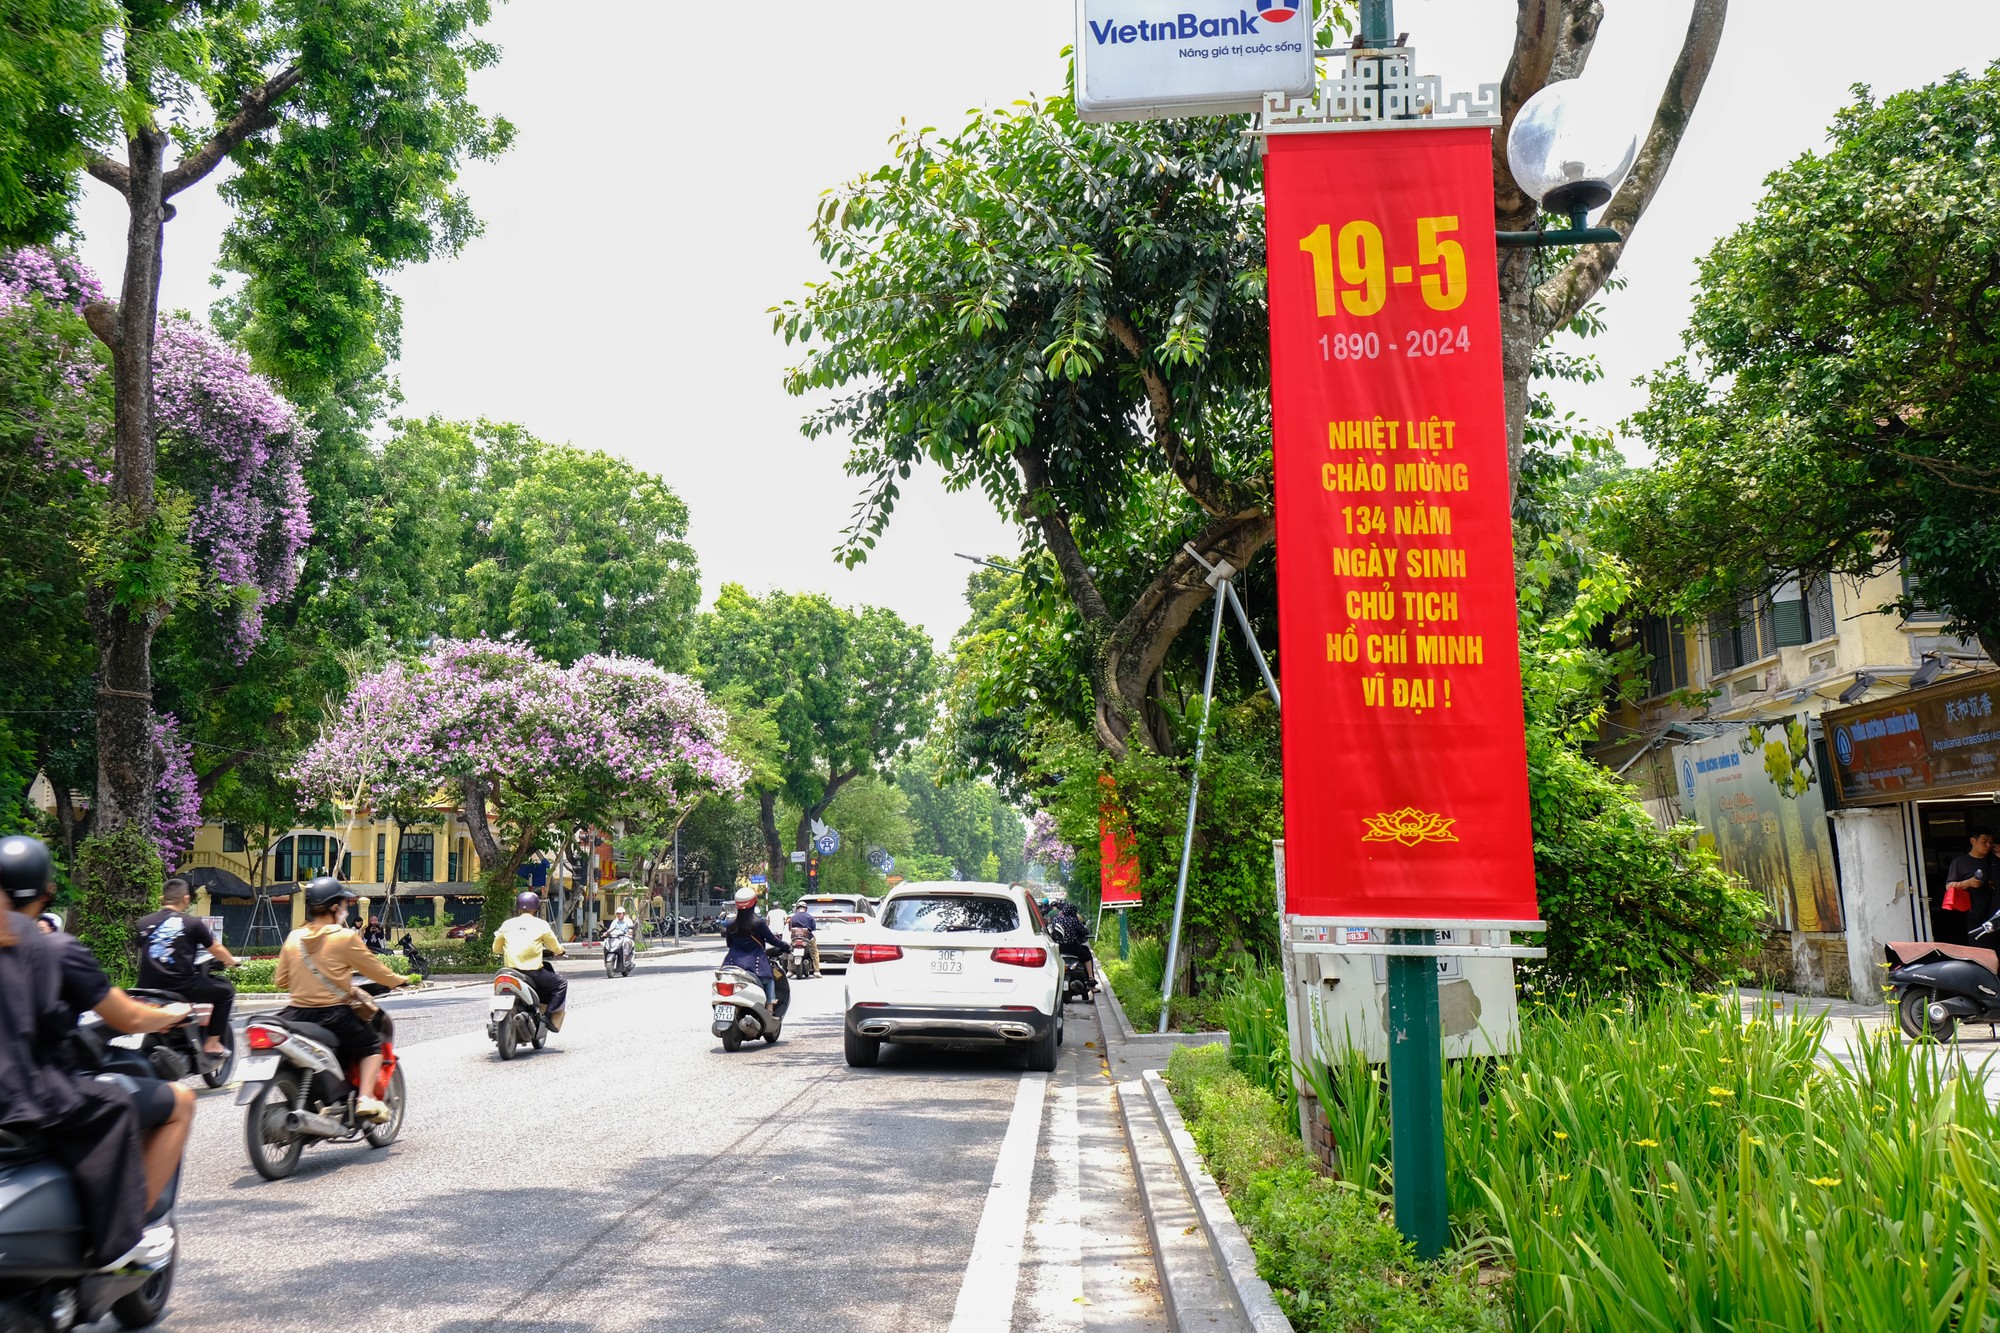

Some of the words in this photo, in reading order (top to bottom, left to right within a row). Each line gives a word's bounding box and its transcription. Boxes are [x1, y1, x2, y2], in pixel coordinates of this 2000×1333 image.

[1089, 9, 1260, 46] VietinBank
[1179, 47, 1208, 59] Nâng
[1211, 44, 1229, 58] giá
[1231, 45, 1243, 57] trị
[1245, 42, 1272, 55] cuộc
[1274, 40, 1302, 54] sống
[1299, 215, 1468, 318] 19-5
[1318, 331, 1381, 361] 1890
[1406, 326, 1471, 358] 2024
[1328, 415, 1399, 456] NHIỆT
[1407, 415, 1456, 457] LIỆT
[1321, 456, 1387, 492] CHÀO
[1394, 456, 1469, 492] MỪNG
[1342, 505, 1387, 535] 134
[1394, 500, 1452, 535] NĂM
[1333, 543, 1399, 577] NGÀY
[1406, 547, 1467, 578] SINH
[1346, 581, 1395, 621] CHỦ
[1402, 591, 1458, 628] TỊCH
[1326, 623, 1359, 663] HỒ
[1366, 628, 1408, 664] CHÍ
[1416, 634, 1484, 665] MINH
[1361, 671, 1385, 707] VĨ
[1392, 678, 1435, 715] ĐẠI
[938, 950, 956, 961] 30E
